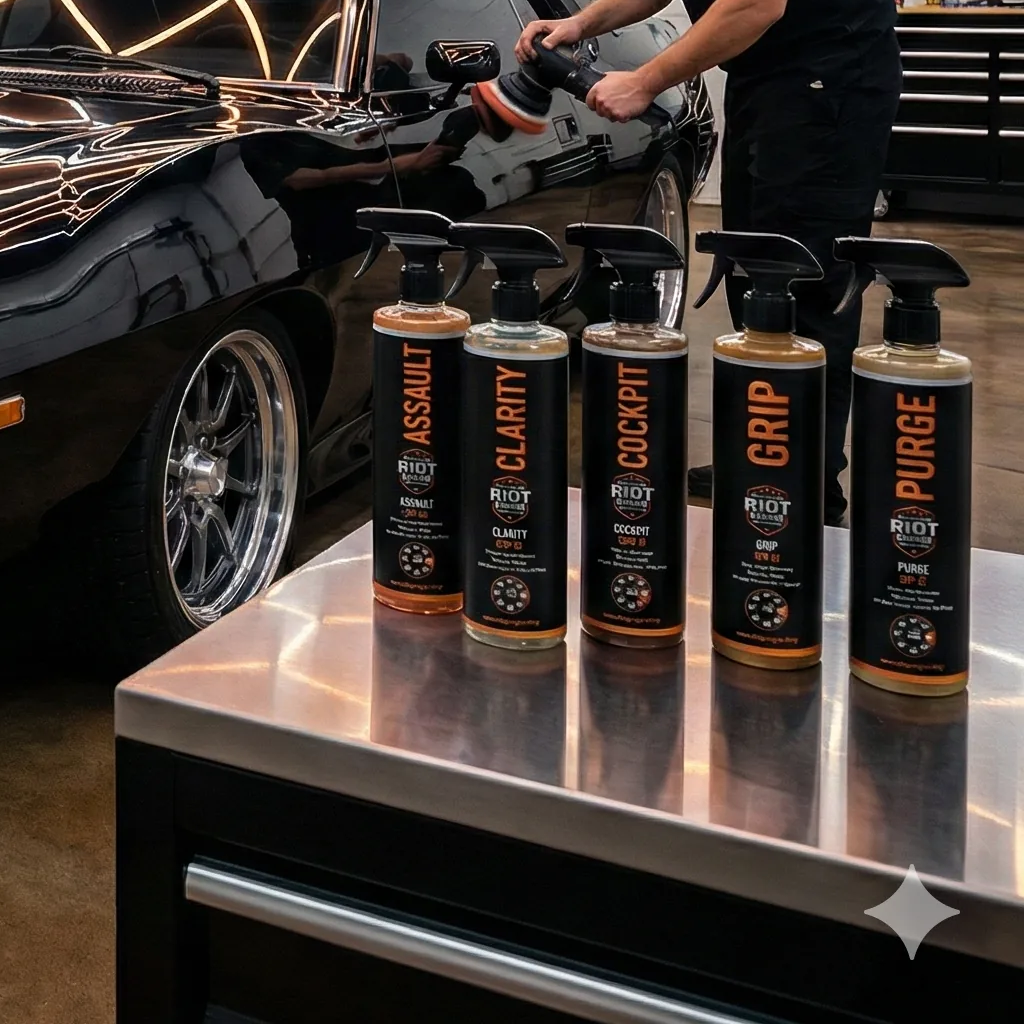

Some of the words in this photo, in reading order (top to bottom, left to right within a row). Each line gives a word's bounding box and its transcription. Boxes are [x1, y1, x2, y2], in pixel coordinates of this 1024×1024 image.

[403, 342, 432, 445] ASSAULT
[496, 365, 526, 471] CLARITY
[617, 362, 649, 469] COCKPIT
[747, 380, 790, 467] GRIP
[896, 392, 936, 501] PURGE
[397, 459, 437, 476] RIOT
[611, 483, 655, 501] RIOT
[490, 487, 532, 503] RIOT
[744, 496, 791, 515] RIOT
[890, 518, 939, 536] RIOT
